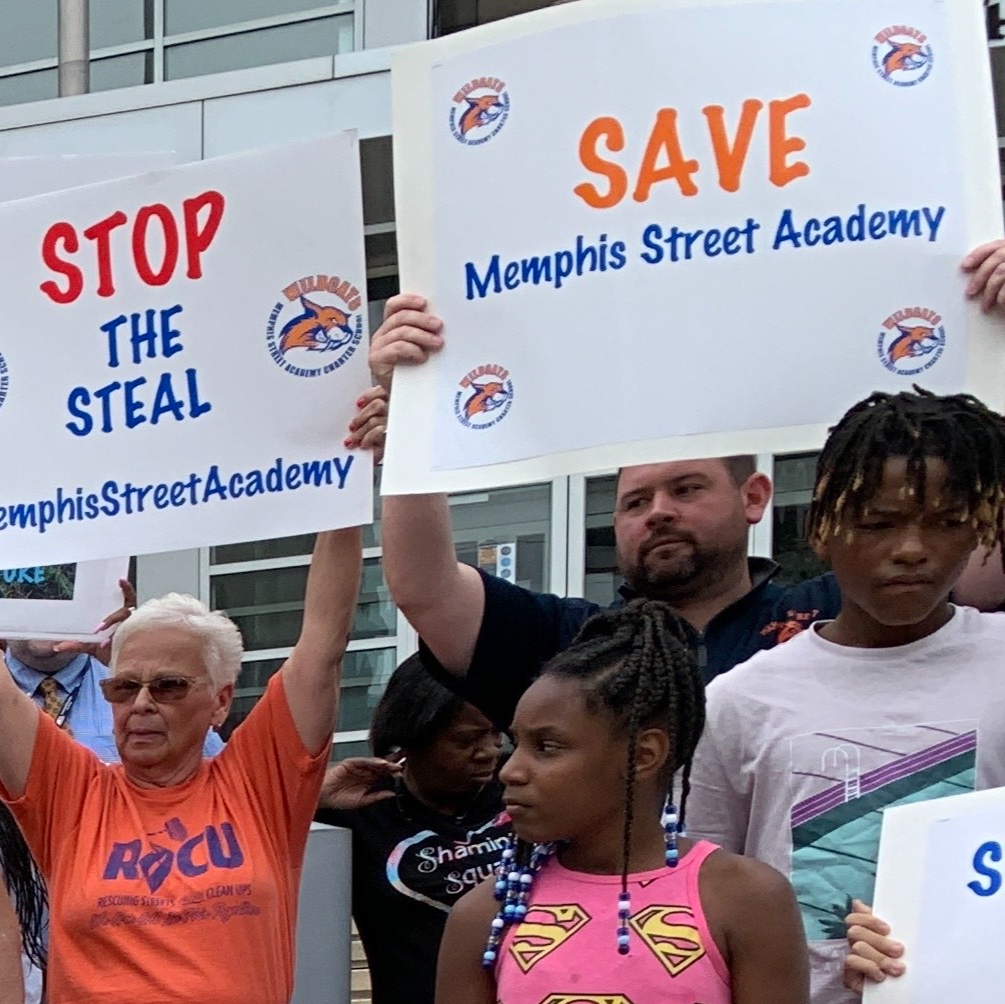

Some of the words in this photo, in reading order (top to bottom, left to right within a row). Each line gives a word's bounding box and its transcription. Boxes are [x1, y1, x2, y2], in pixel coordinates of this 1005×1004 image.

[574, 94, 811, 209] SAVE
[40, 191, 226, 305] STOP
[464, 235, 627, 300] Memphis
[641, 219, 759, 265] Street
[773, 205, 946, 249] Academy
[101, 305, 183, 368] THE
[66, 368, 212, 437] STEAL
[415, 836, 510, 873] Shamin
